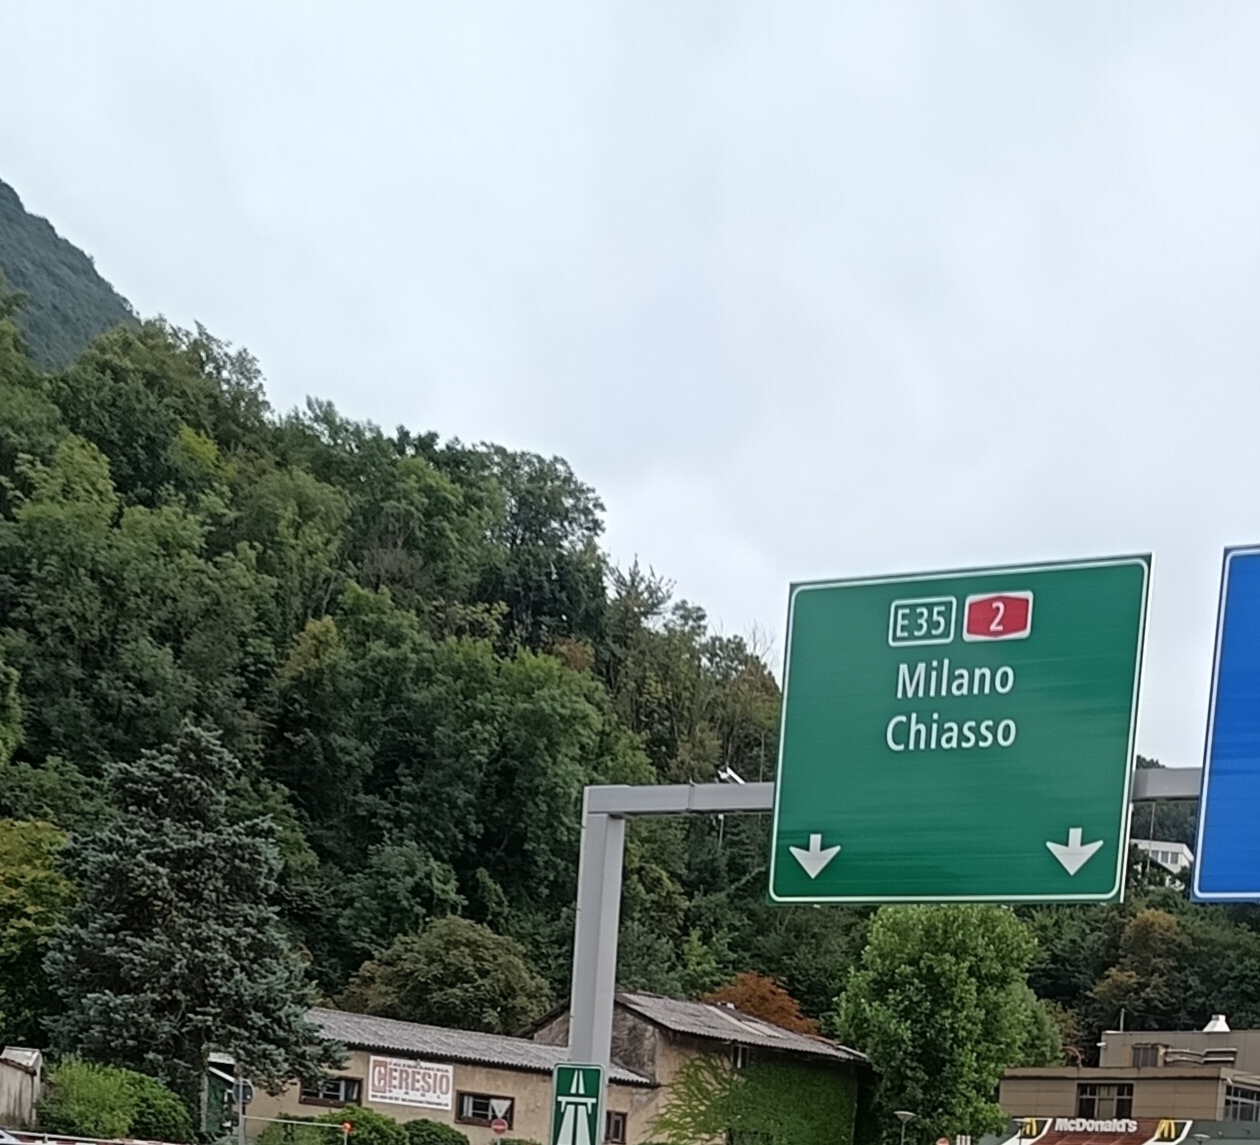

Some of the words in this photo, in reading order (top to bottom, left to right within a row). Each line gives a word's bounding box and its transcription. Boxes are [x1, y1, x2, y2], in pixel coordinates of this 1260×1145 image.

[989, 601, 1005, 632] 2
[896, 657, 1015, 700] Milano
[885, 712, 1018, 752] Chiasso
[373, 1063, 450, 1095] CERESIO
[1054, 1117, 1138, 1133] McDonald's
